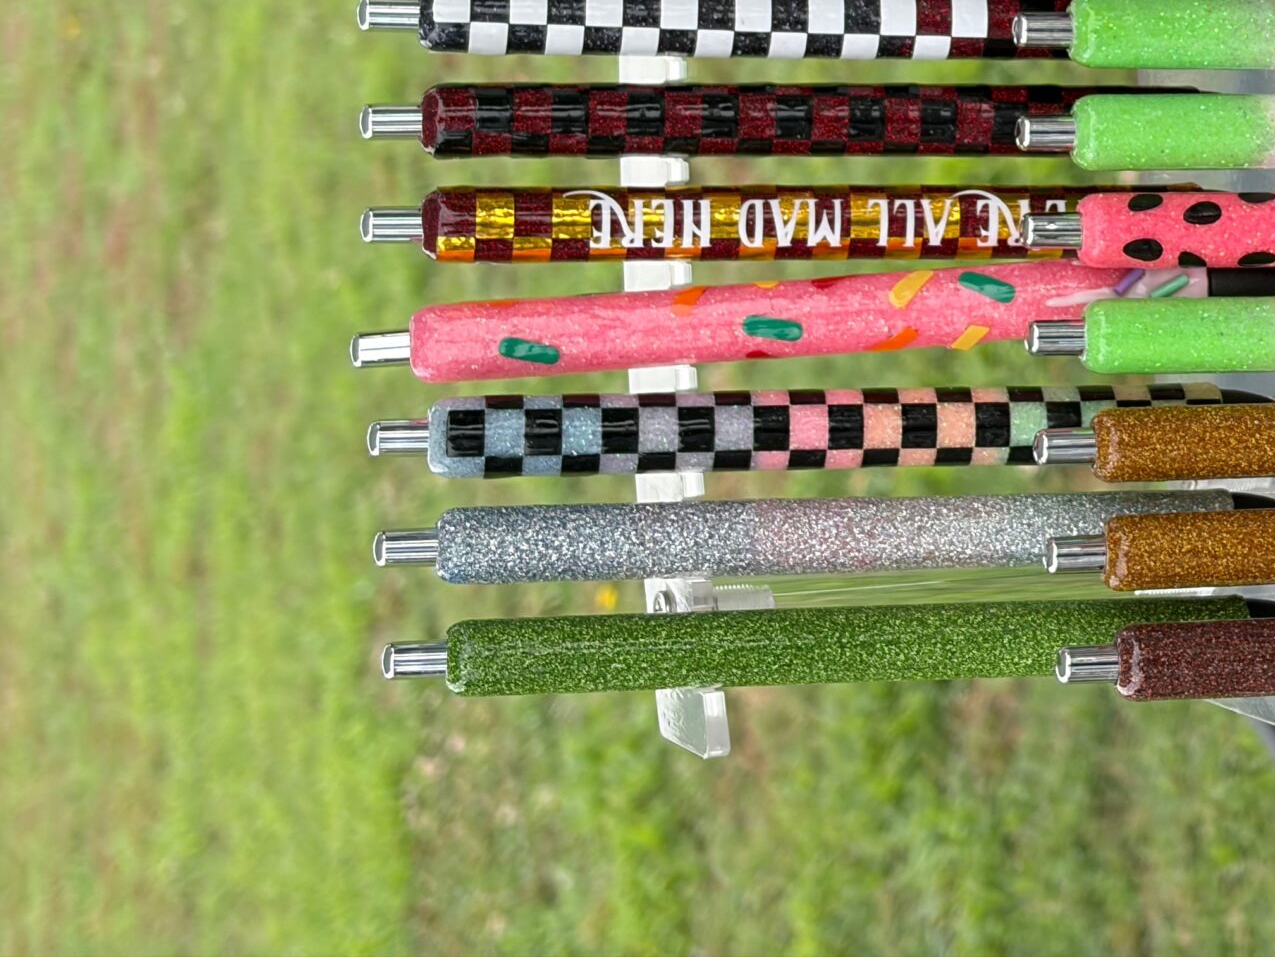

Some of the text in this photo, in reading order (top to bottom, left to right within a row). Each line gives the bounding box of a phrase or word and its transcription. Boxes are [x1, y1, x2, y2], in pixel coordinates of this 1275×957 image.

[562, 189, 712, 249] HERE
[737, 197, 843, 248] MAD
[866, 197, 953, 248] ALL
